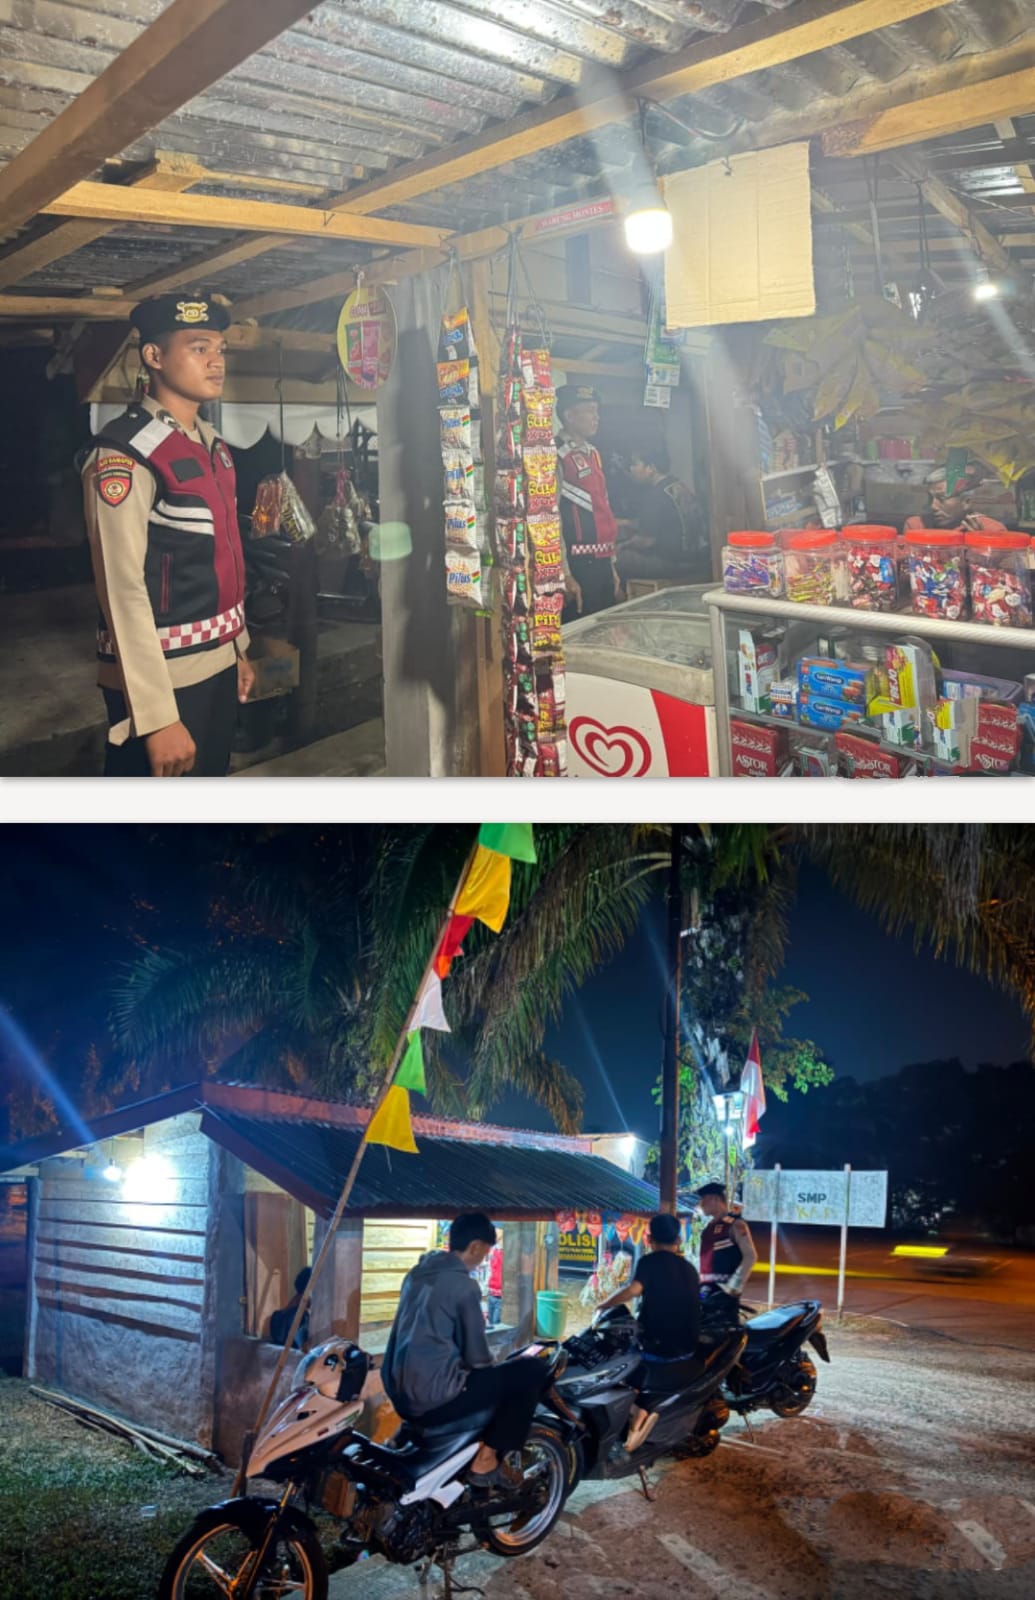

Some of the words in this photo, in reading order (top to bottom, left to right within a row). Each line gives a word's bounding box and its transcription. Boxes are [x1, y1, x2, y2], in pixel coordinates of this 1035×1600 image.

[448, 572, 470, 583] Pilus
[736, 754, 768, 771] ASTOR
[797, 1192, 828, 1204] SMP
[559, 1233, 596, 1247] OLISI
